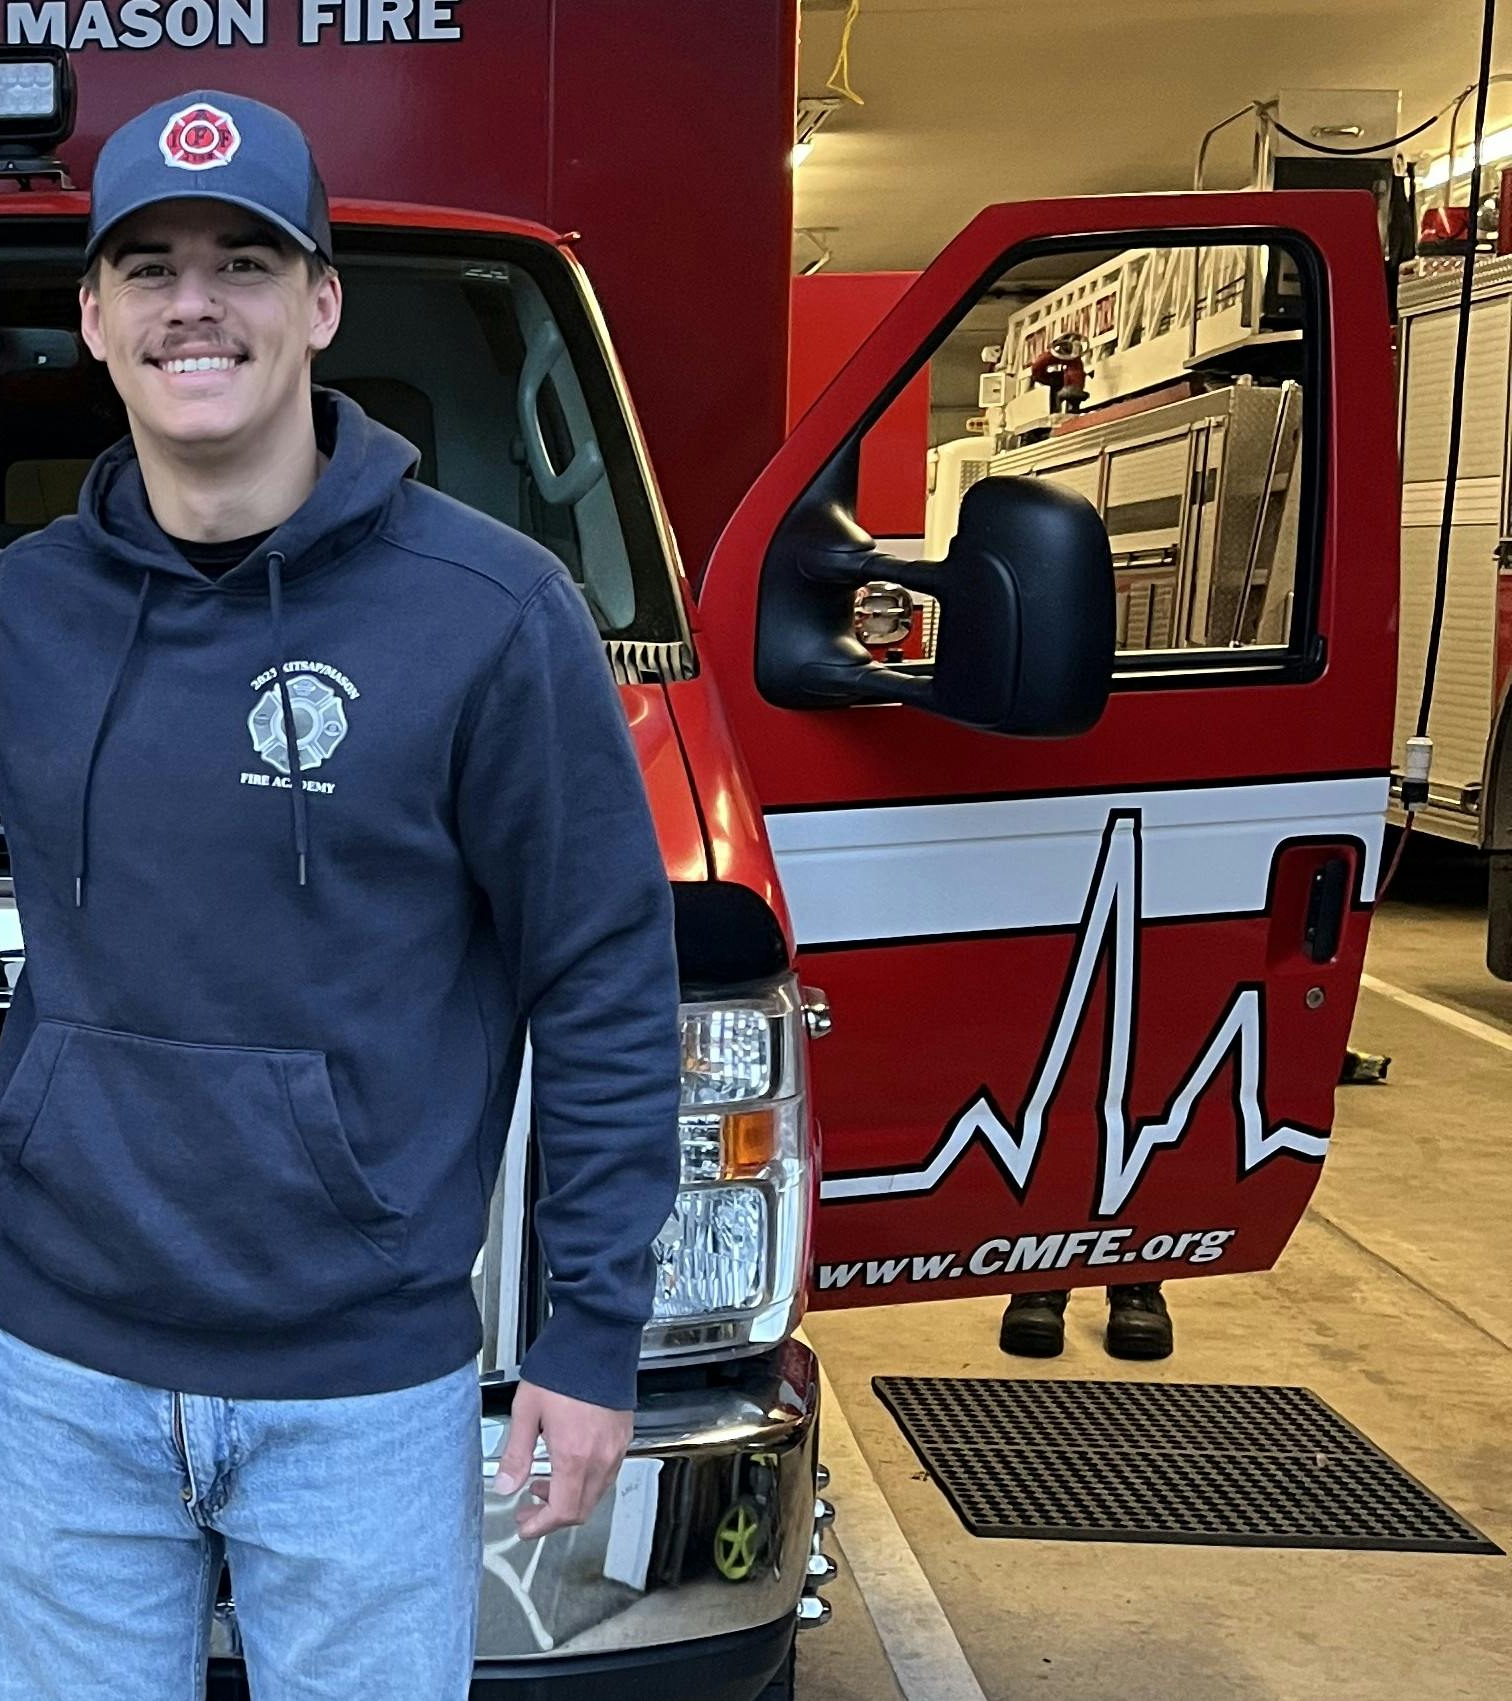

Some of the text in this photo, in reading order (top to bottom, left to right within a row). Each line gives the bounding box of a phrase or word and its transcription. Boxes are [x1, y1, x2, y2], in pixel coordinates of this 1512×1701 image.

[6, 0, 265, 49] MASON
[302, 0, 462, 44] FIRE
[240, 772, 336, 794] FIRE ACDEMY
[819, 1227, 1236, 1289] www.CMFE.org
